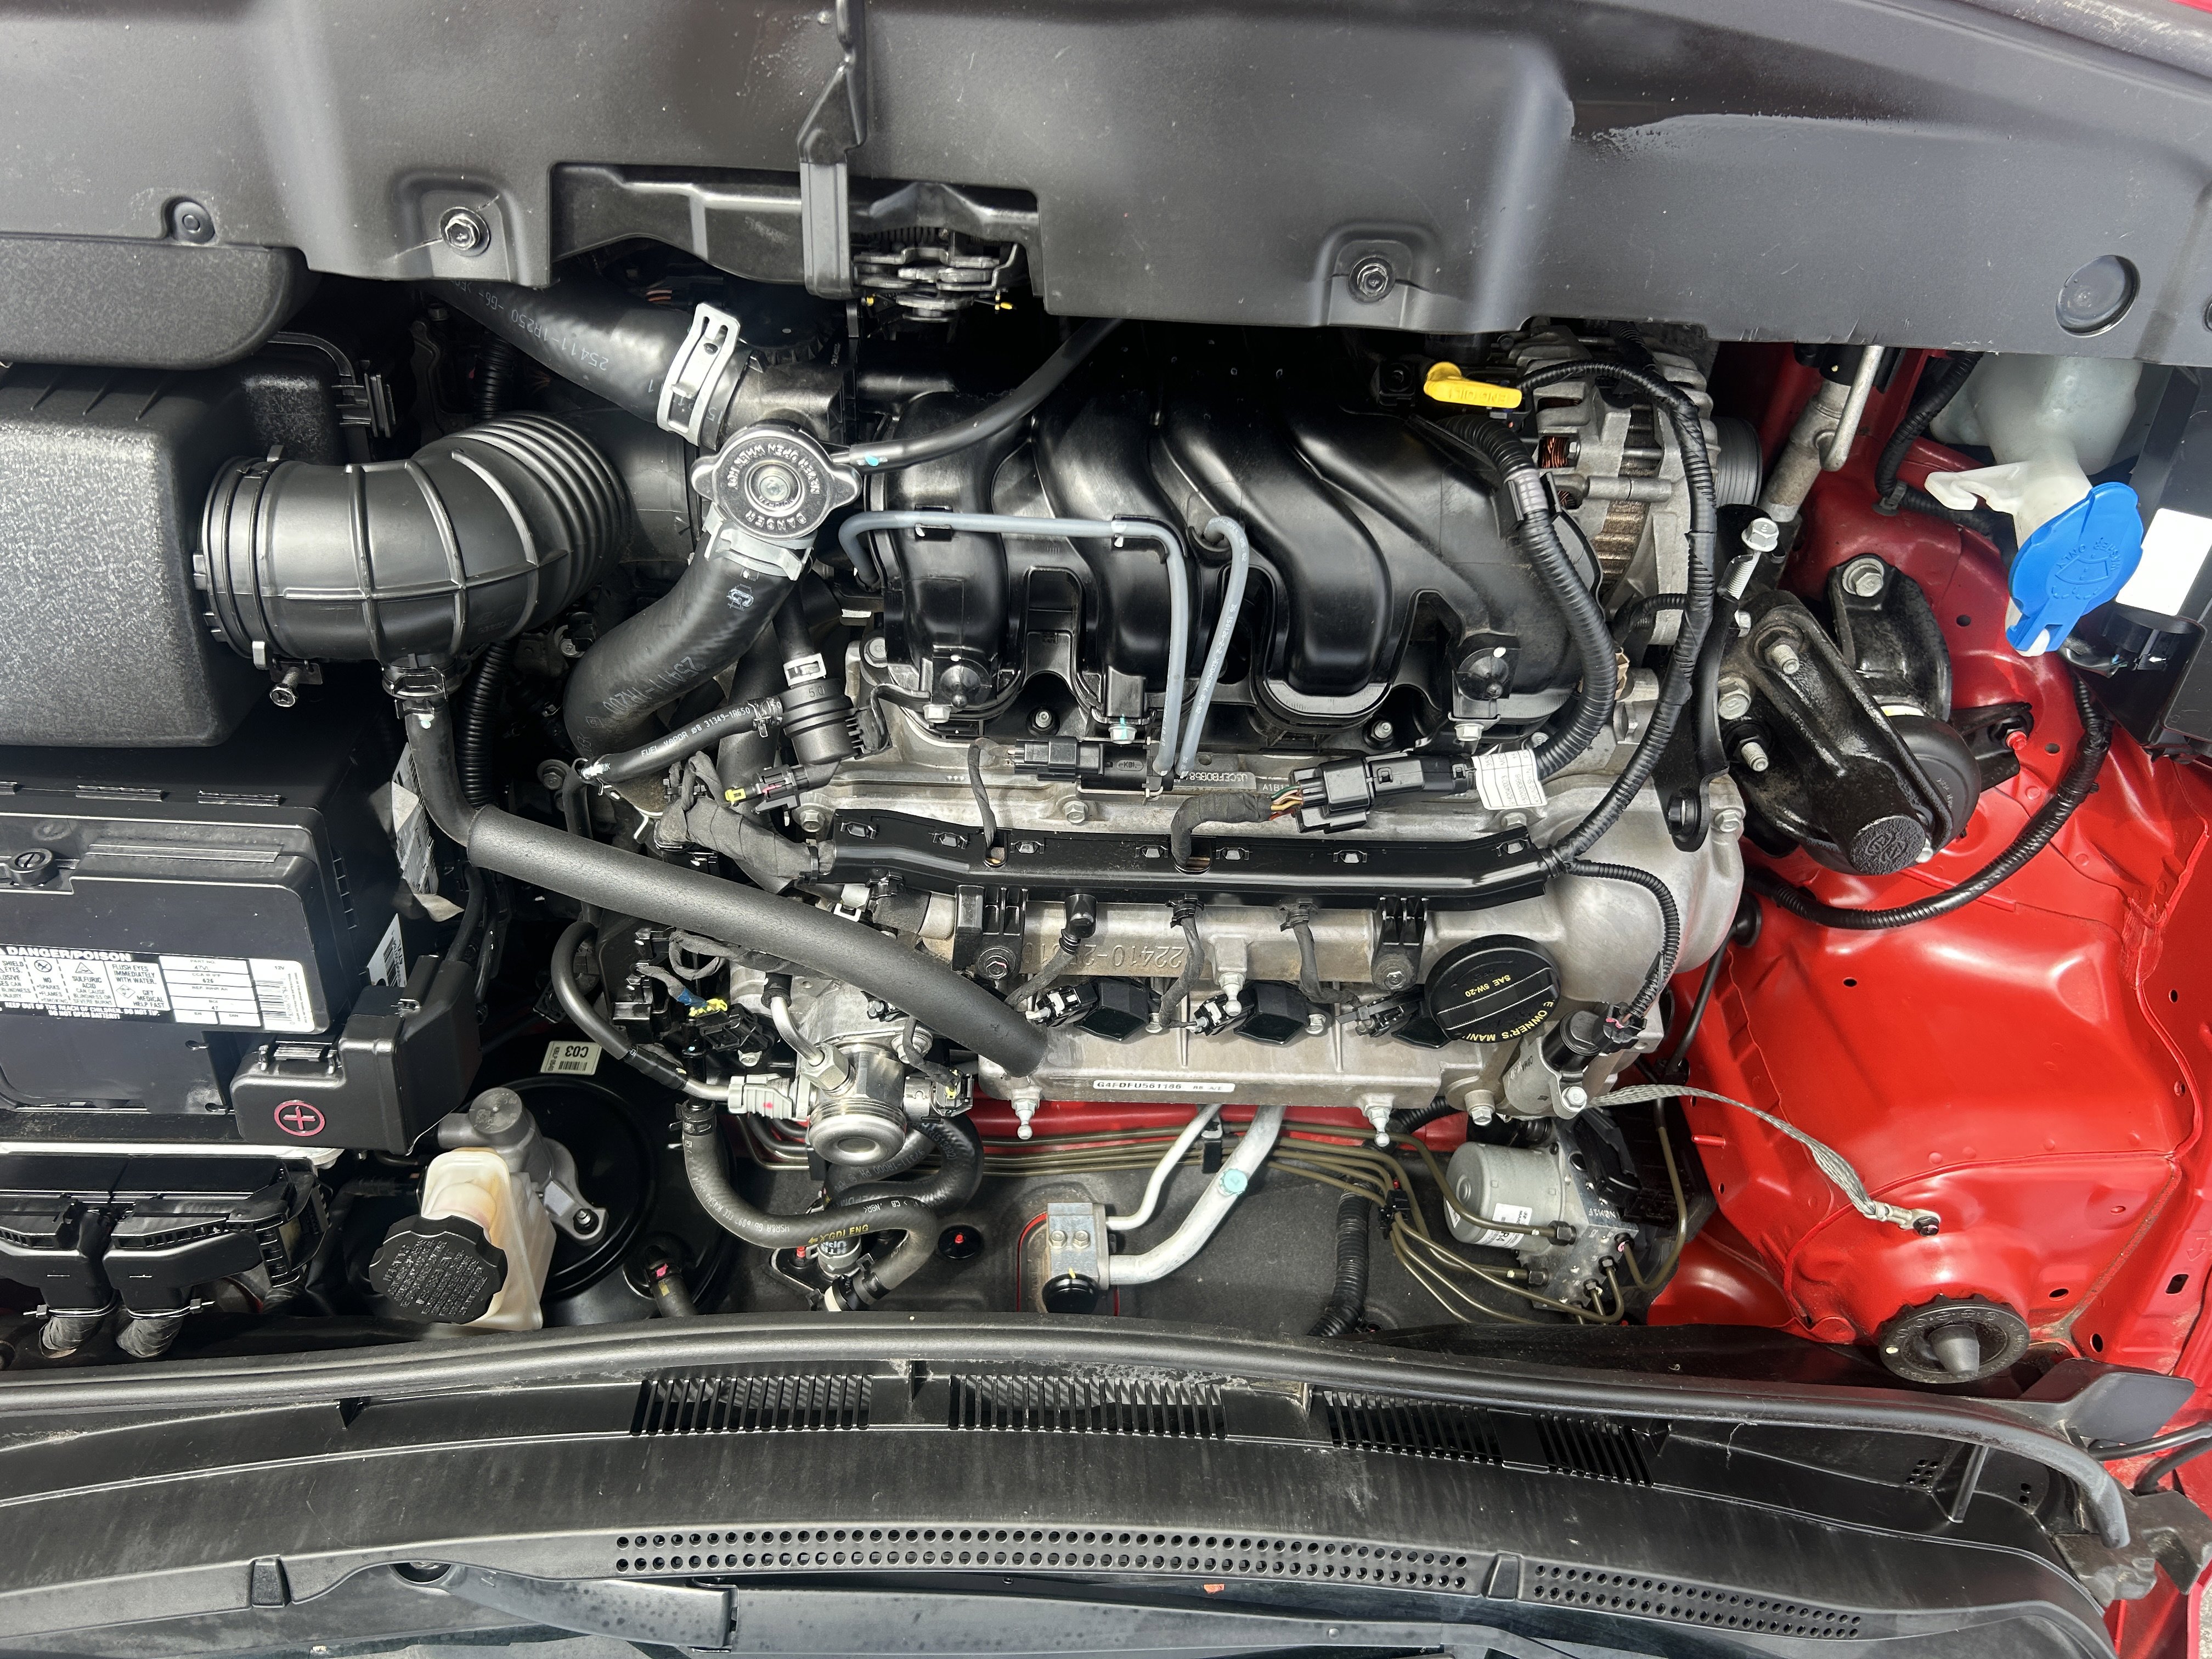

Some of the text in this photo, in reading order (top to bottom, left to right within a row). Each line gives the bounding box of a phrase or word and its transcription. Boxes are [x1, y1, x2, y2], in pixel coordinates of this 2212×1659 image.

[1480, 392, 1508, 404] ENG
[733, 444, 766, 469] WHEN
[768, 443, 799, 462] OPEN
[745, 509, 807, 531] DANGER
[2056, 543, 2086, 570] ONLY
[703, 707, 751, 729] 31349-1R650
[6, 946, 132, 962] DANGER/POISON
[1465, 975, 1511, 997] SAE 5W-20
[1501, 1010, 1548, 1039] OWNER'S
[565, 1045, 589, 1058] C03
[849, 1224, 869, 1235] ENG
